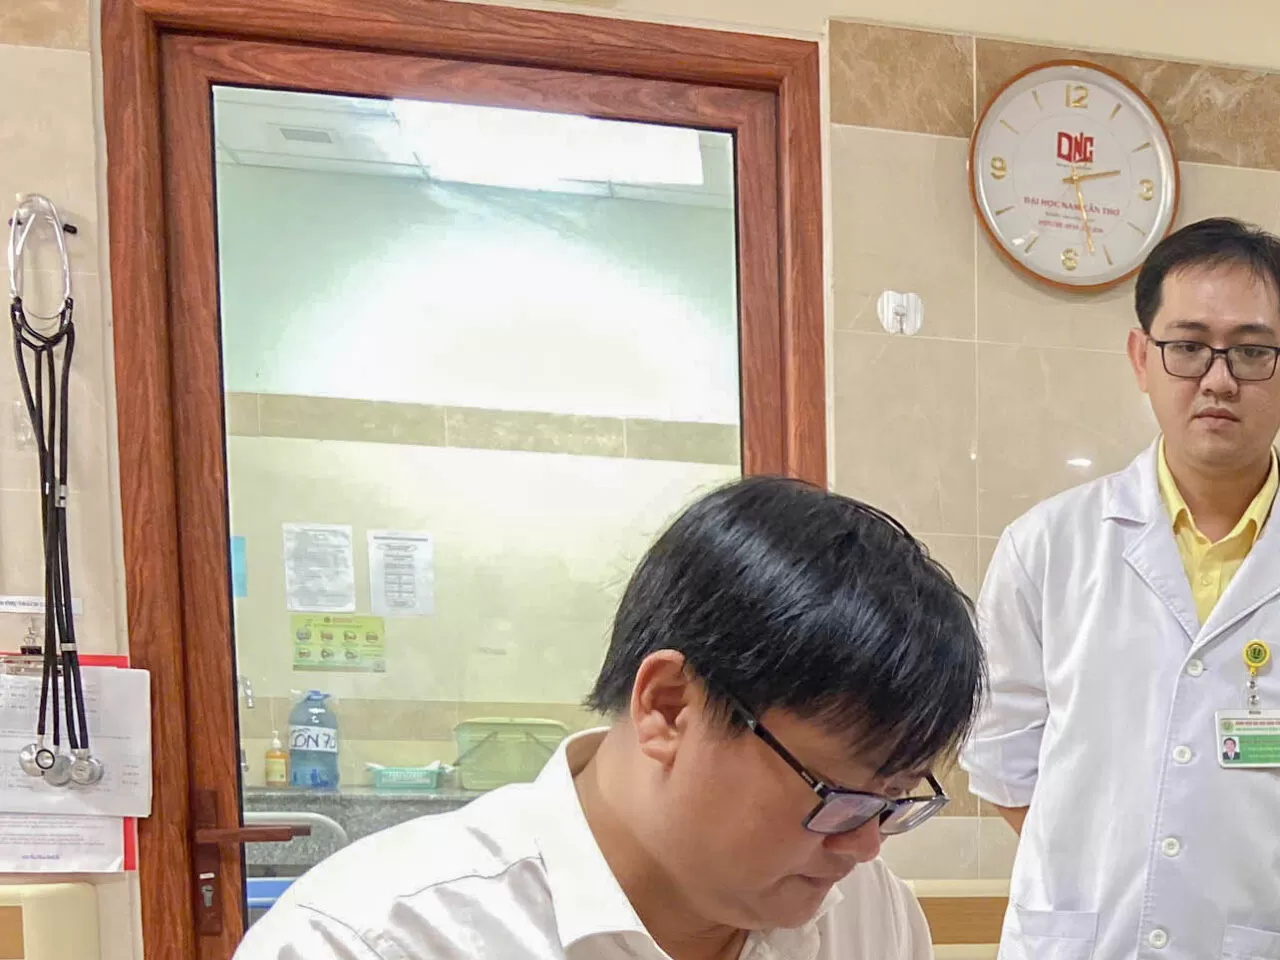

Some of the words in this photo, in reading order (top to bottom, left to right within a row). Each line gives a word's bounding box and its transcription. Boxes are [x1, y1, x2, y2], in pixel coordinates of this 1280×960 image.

[1064, 84, 1089, 109] 12
[990, 156, 1007, 180] 9
[1139, 179, 1154, 201] 3
